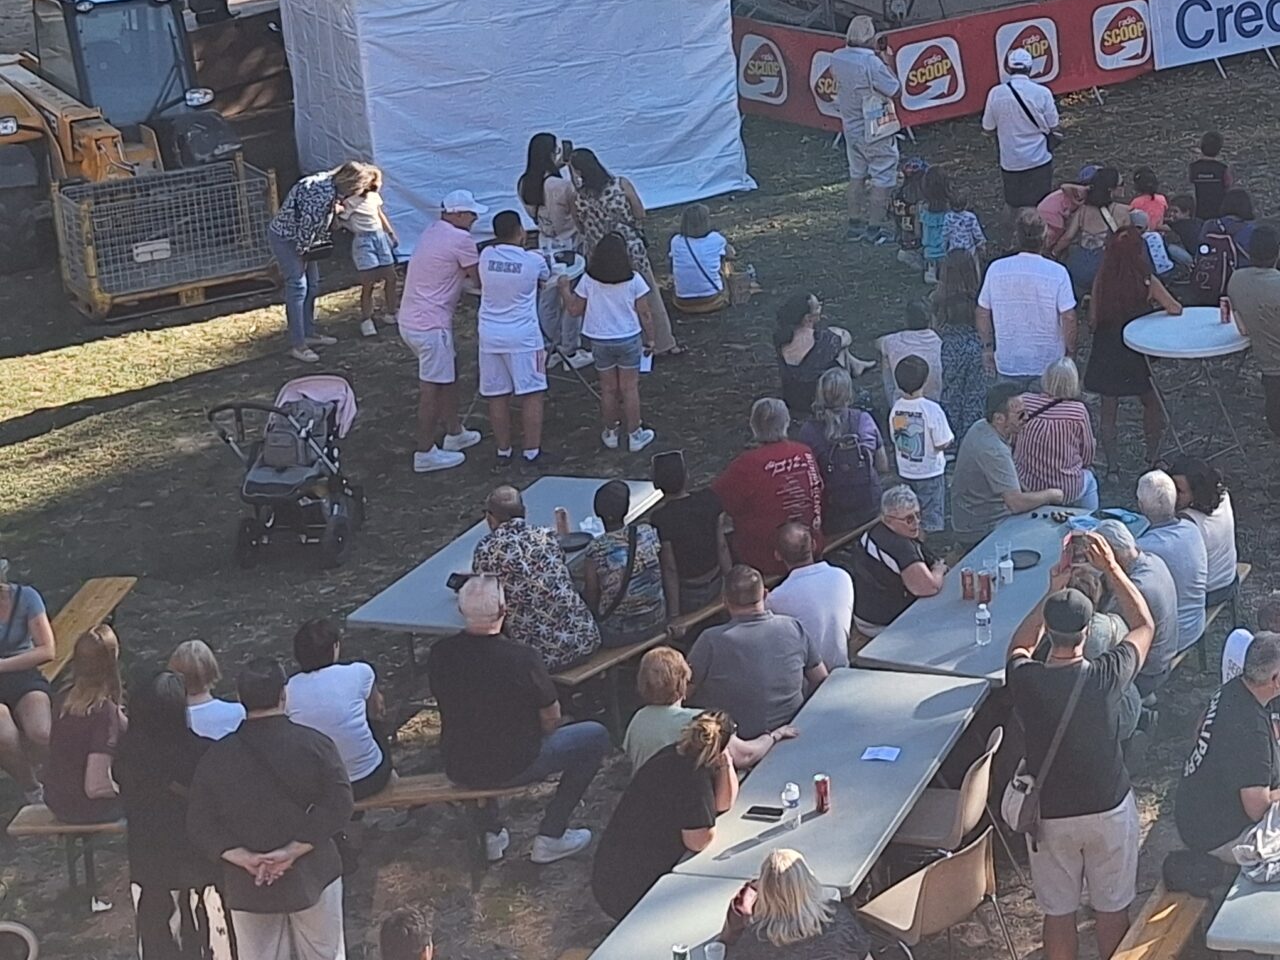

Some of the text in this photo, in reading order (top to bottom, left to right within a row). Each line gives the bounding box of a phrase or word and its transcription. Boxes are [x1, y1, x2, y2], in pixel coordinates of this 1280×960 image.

[1104, 21, 1145, 47] SCOOP
[748, 60, 780, 76] SCOOP
[908, 59, 951, 86] SCOOP
